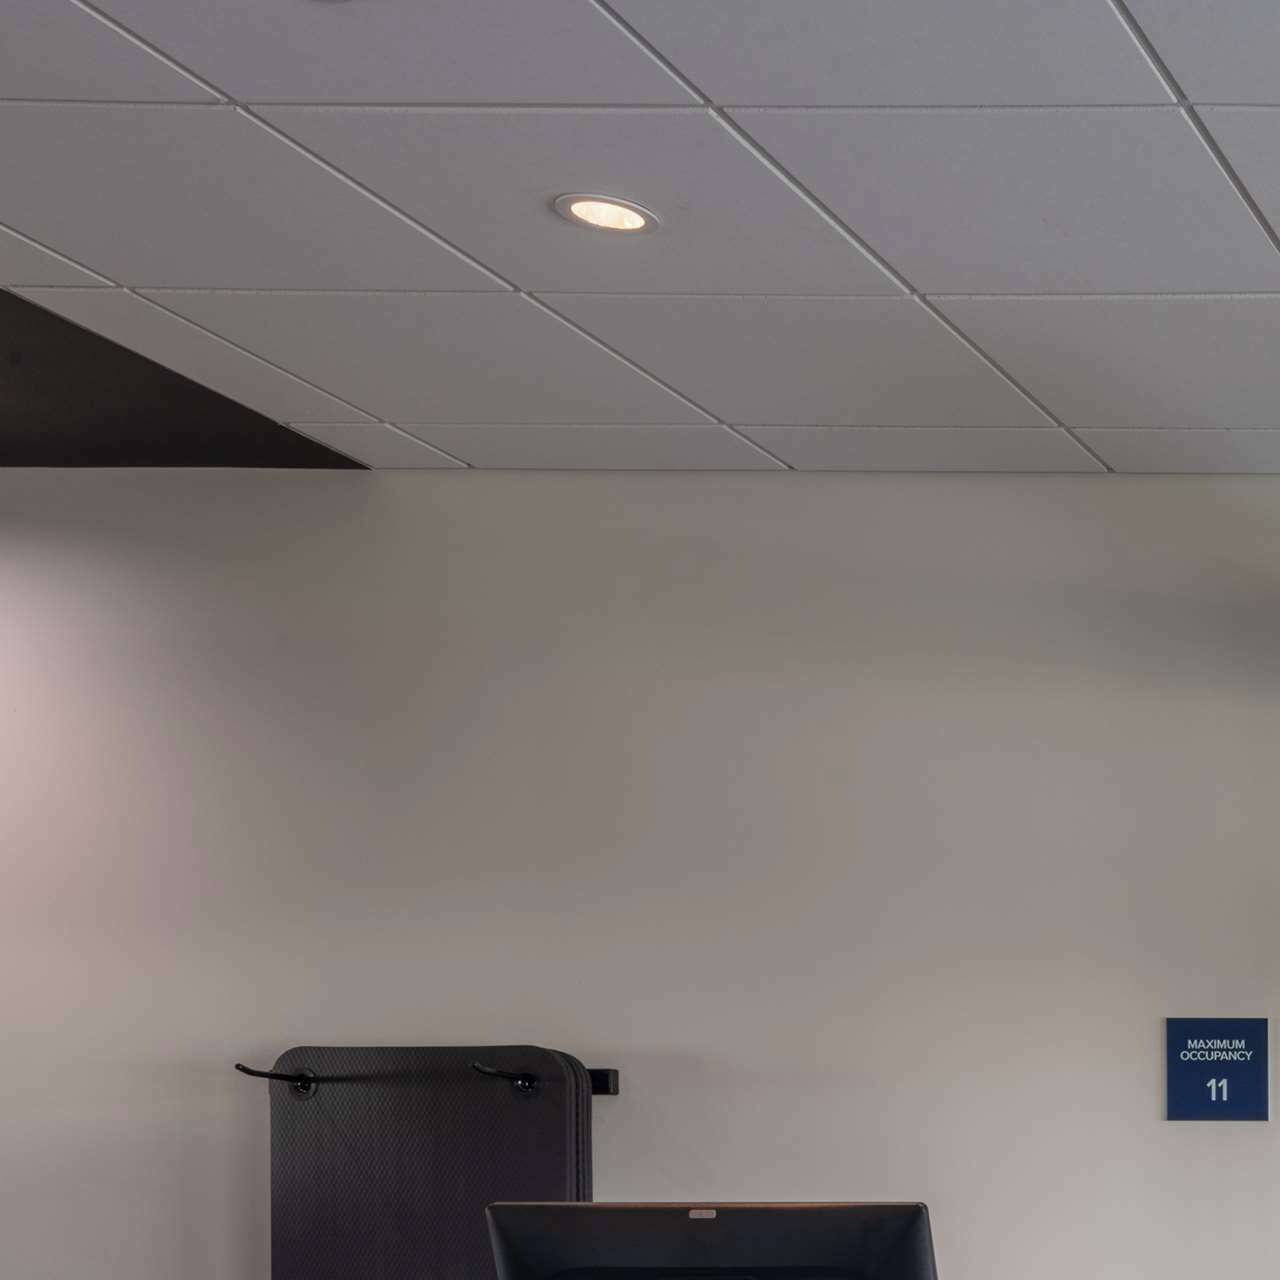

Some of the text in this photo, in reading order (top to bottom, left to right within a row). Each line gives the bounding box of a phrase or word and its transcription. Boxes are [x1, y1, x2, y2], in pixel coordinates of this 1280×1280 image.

[1187, 1039, 1246, 1050] MAXIMUM
[1179, 1050, 1253, 1061] OCCUPANCY
[1205, 1077, 1229, 1102] 11
